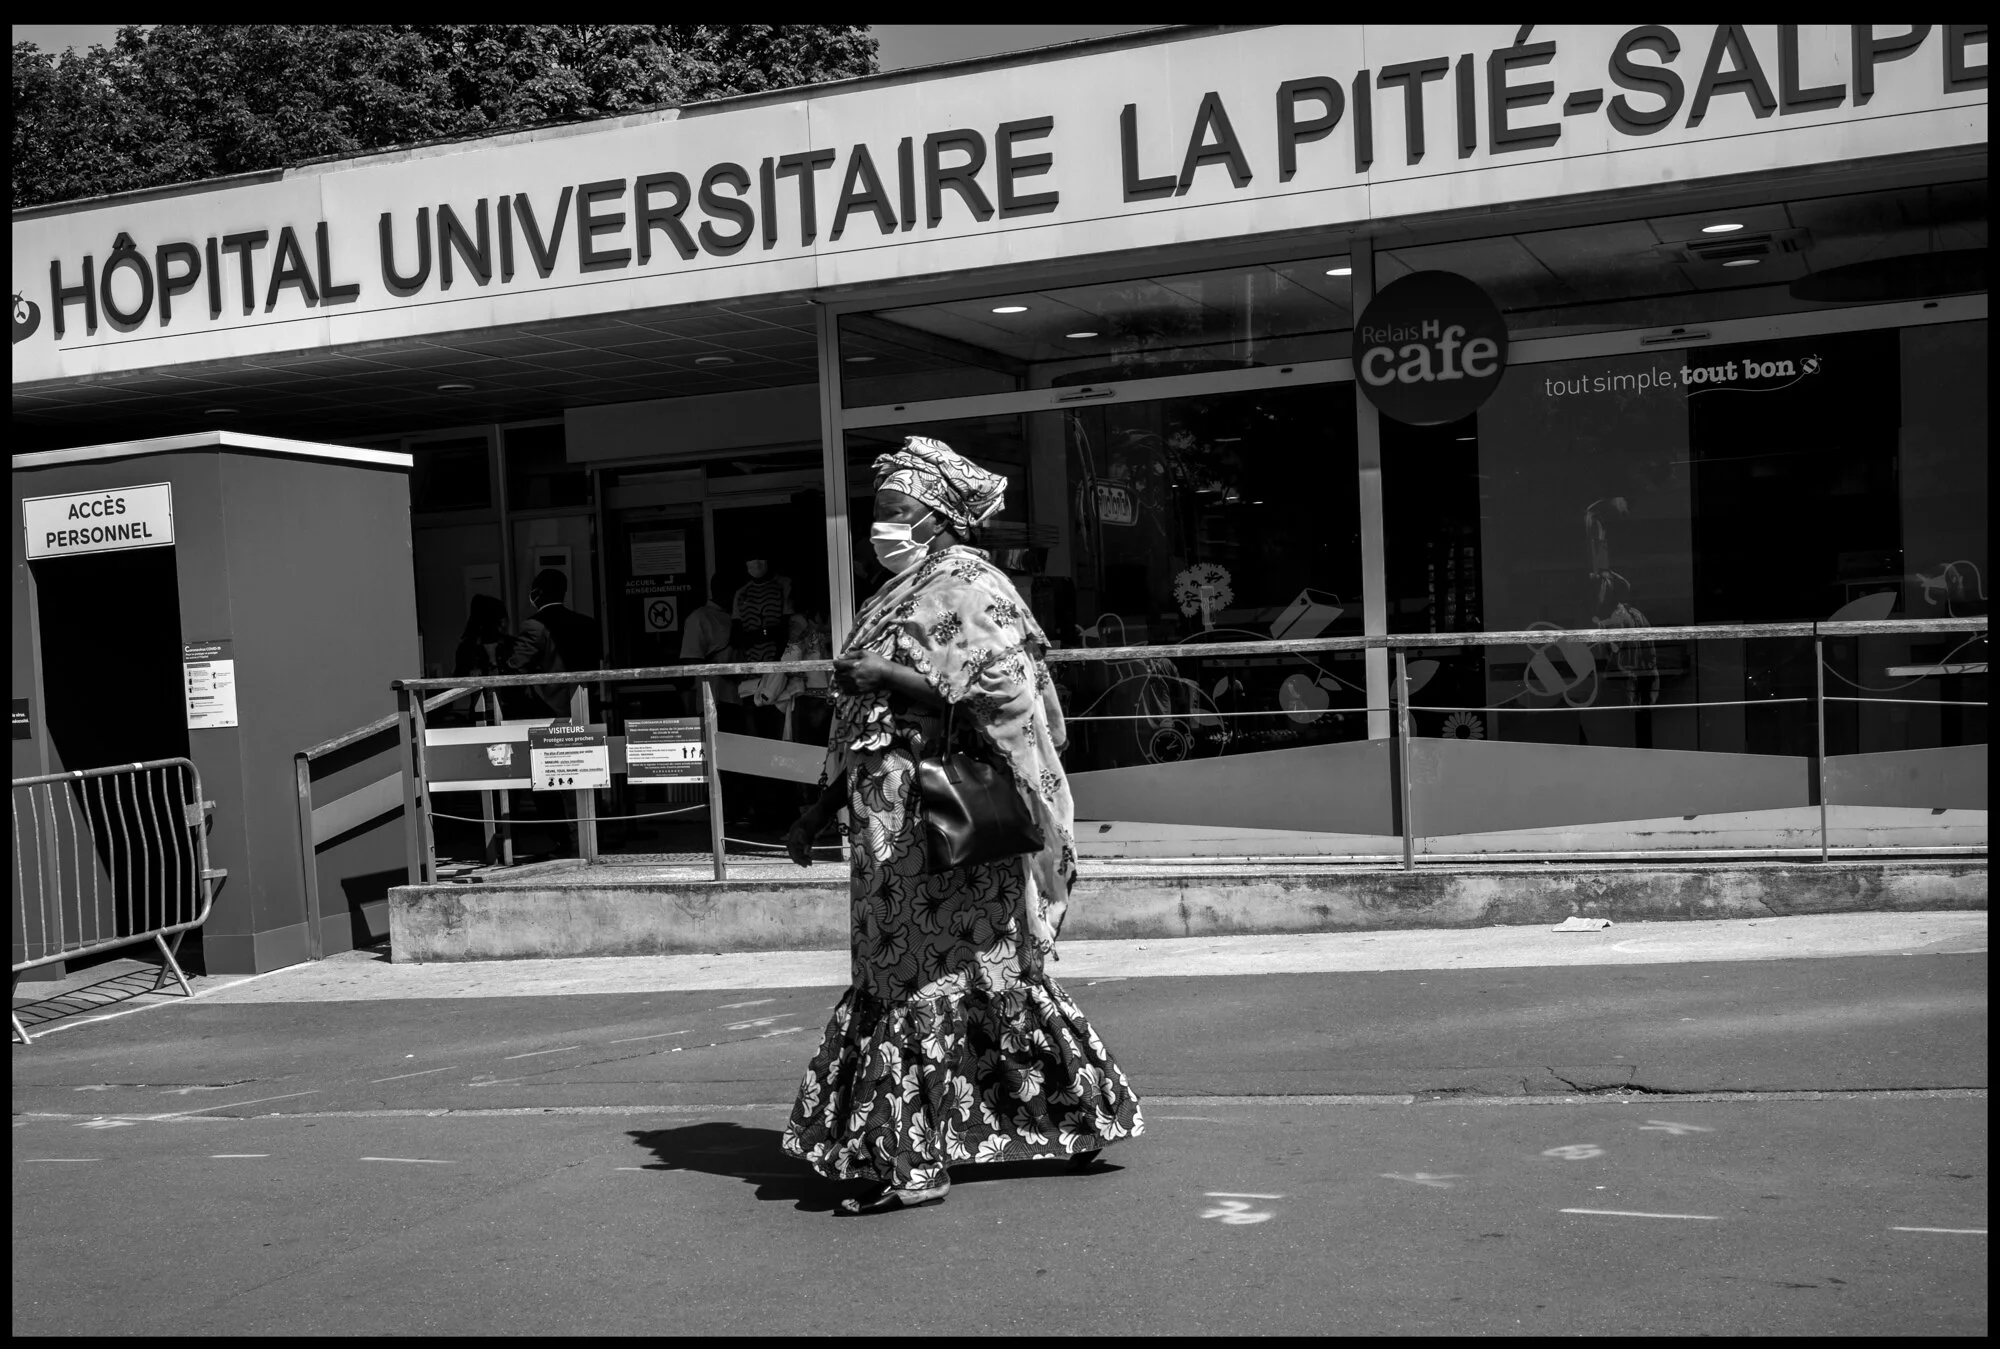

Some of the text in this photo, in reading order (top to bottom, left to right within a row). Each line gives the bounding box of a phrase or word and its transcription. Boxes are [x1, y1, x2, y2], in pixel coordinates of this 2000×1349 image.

[50, 232, 360, 338] HÔPITAL
[378, 115, 1059, 295] UNIVERSITAIRE
[1119, 91, 1253, 203] LA
[1361, 325, 1499, 386] cafe
[1545, 359, 1796, 397] tout simple, tout bon
[68, 494, 127, 521] ACCÈS
[46, 522, 153, 549] PERSONNEL
[625, 579, 656, 587] ACCUEIL
[548, 726, 585, 734] VISITEURS
